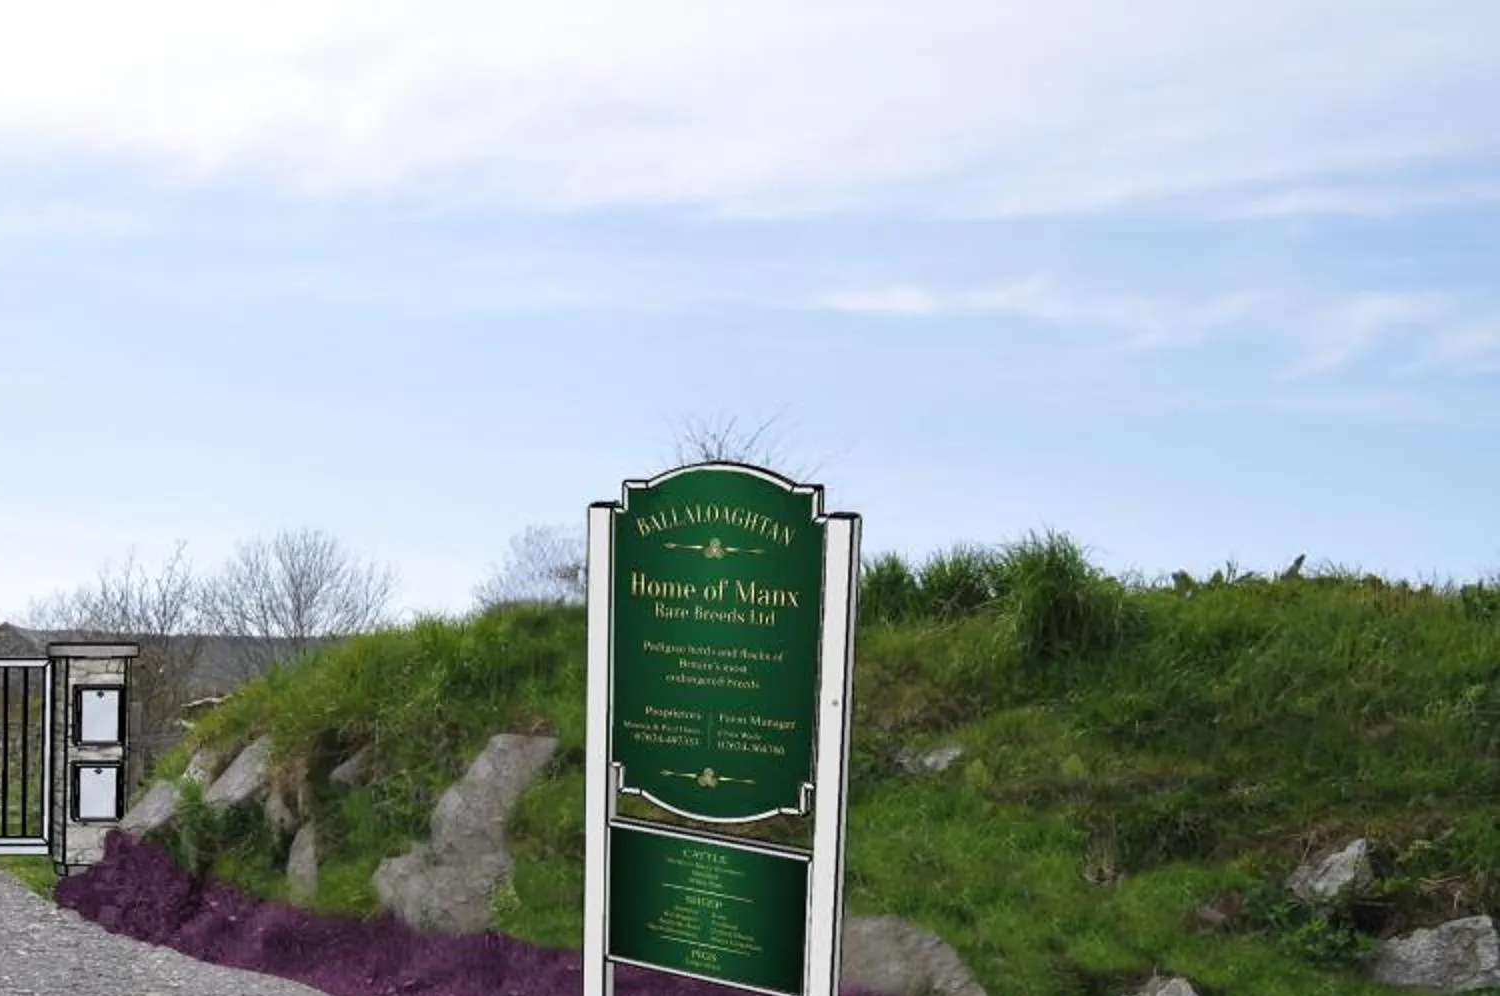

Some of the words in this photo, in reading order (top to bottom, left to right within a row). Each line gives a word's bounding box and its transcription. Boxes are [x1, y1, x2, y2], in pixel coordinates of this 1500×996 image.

[631, 571, 696, 599] Home
[703, 577, 729, 601] of
[735, 579, 800, 608] Manx
[654, 602, 690, 620] Rare
[694, 605, 745, 624] Breeds
[750, 609, 776, 626] Ltd
